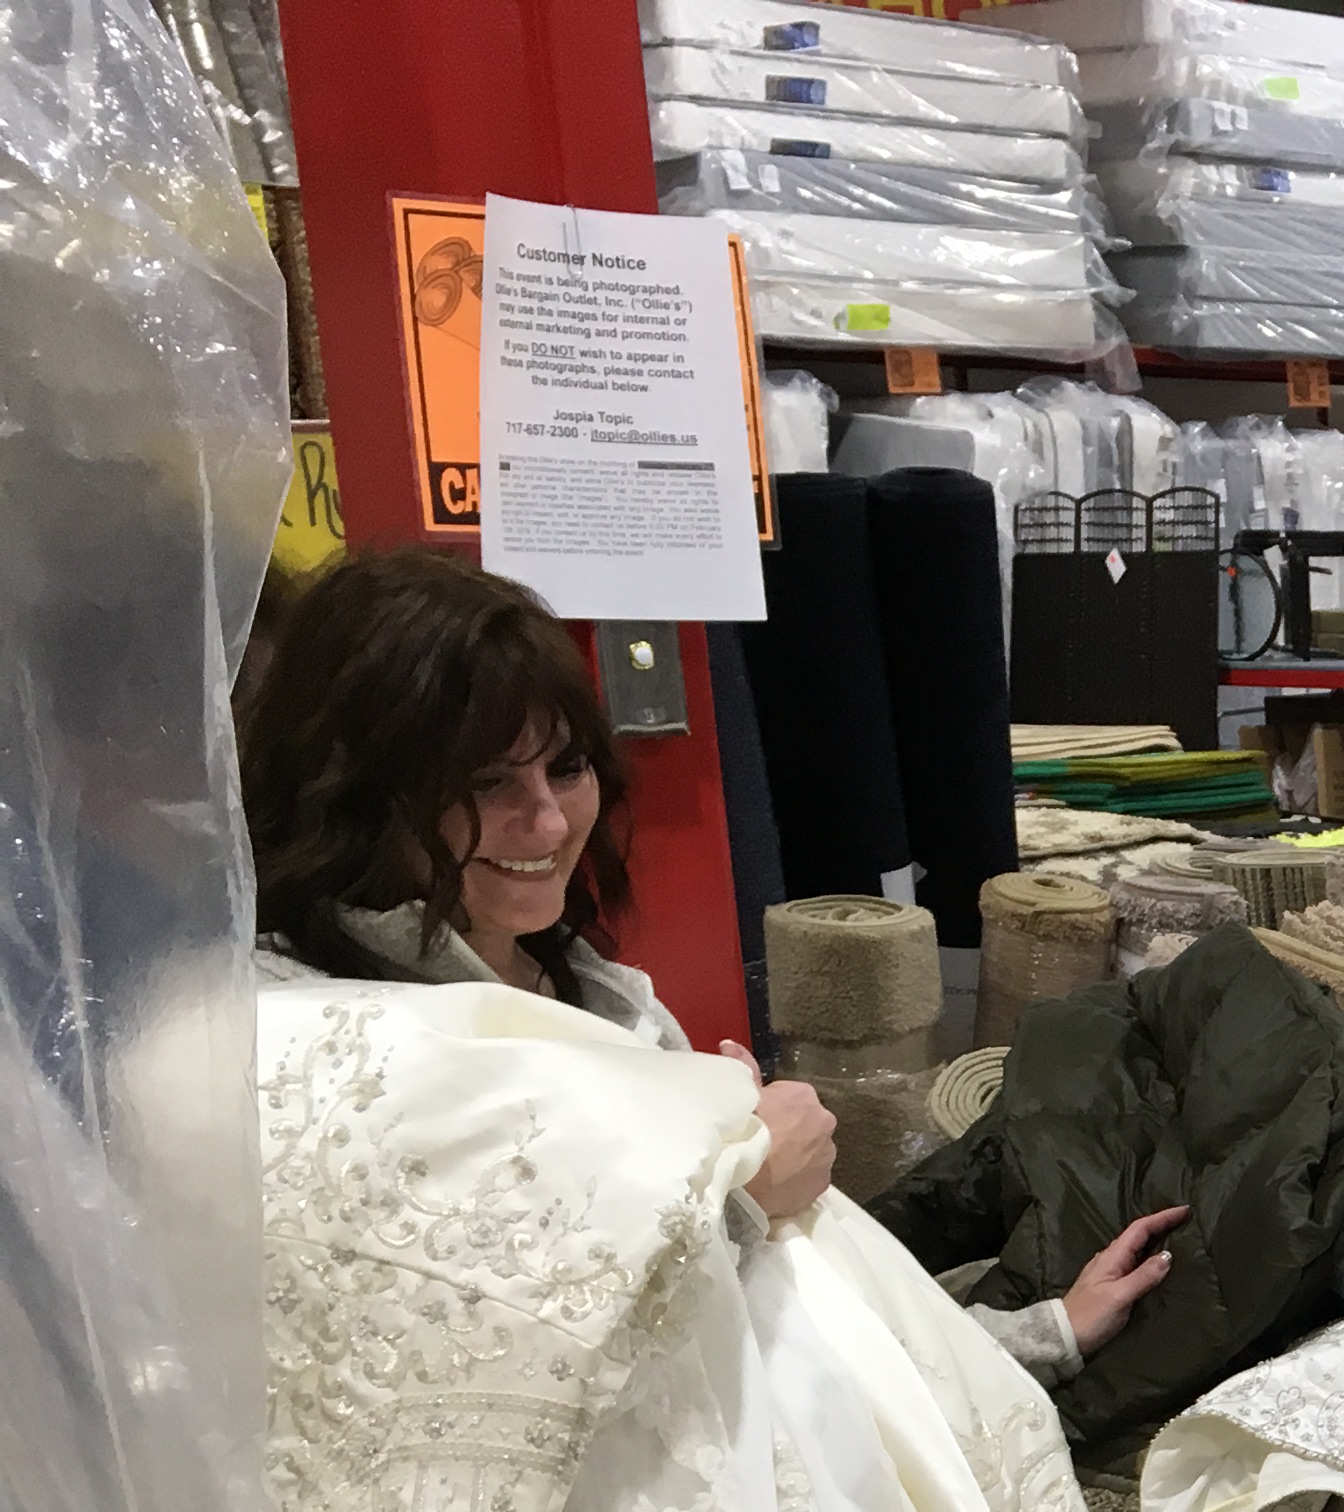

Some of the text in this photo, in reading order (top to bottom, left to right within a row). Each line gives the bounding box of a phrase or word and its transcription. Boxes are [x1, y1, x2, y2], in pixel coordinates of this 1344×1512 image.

[517, 243, 646, 270] Customer Notice
[516, 273, 542, 283] event
[545, 274, 553, 285] is
[557, 276, 588, 291] being
[592, 280, 684, 296] photographed.
[521, 287, 560, 302] Bargain
[605, 297, 627, 308] Inc.
[518, 305, 534, 315] use
[537, 305, 553, 317] the
[557, 307, 598, 322] images
[601, 308, 619, 322] for
[623, 312, 670, 326] internal
[674, 316, 687, 326] or
[499, 319, 689, 343] external marketing and promotion.
[512, 343, 529, 353] you
[531, 342, 547, 355] DO
[551, 344, 575, 358] NOT
[579, 346, 606, 359] wish
[610, 349, 622, 360] to
[626, 352, 668, 365] appear
[673, 352, 684, 363] in
[500, 356, 523, 368] these
[604, 365, 644, 378] please
[647, 368, 694, 379] contact
[531, 375, 548, 386] the
[552, 376, 608, 391] individual
[553, 409, 634, 426] Jospia Topic
